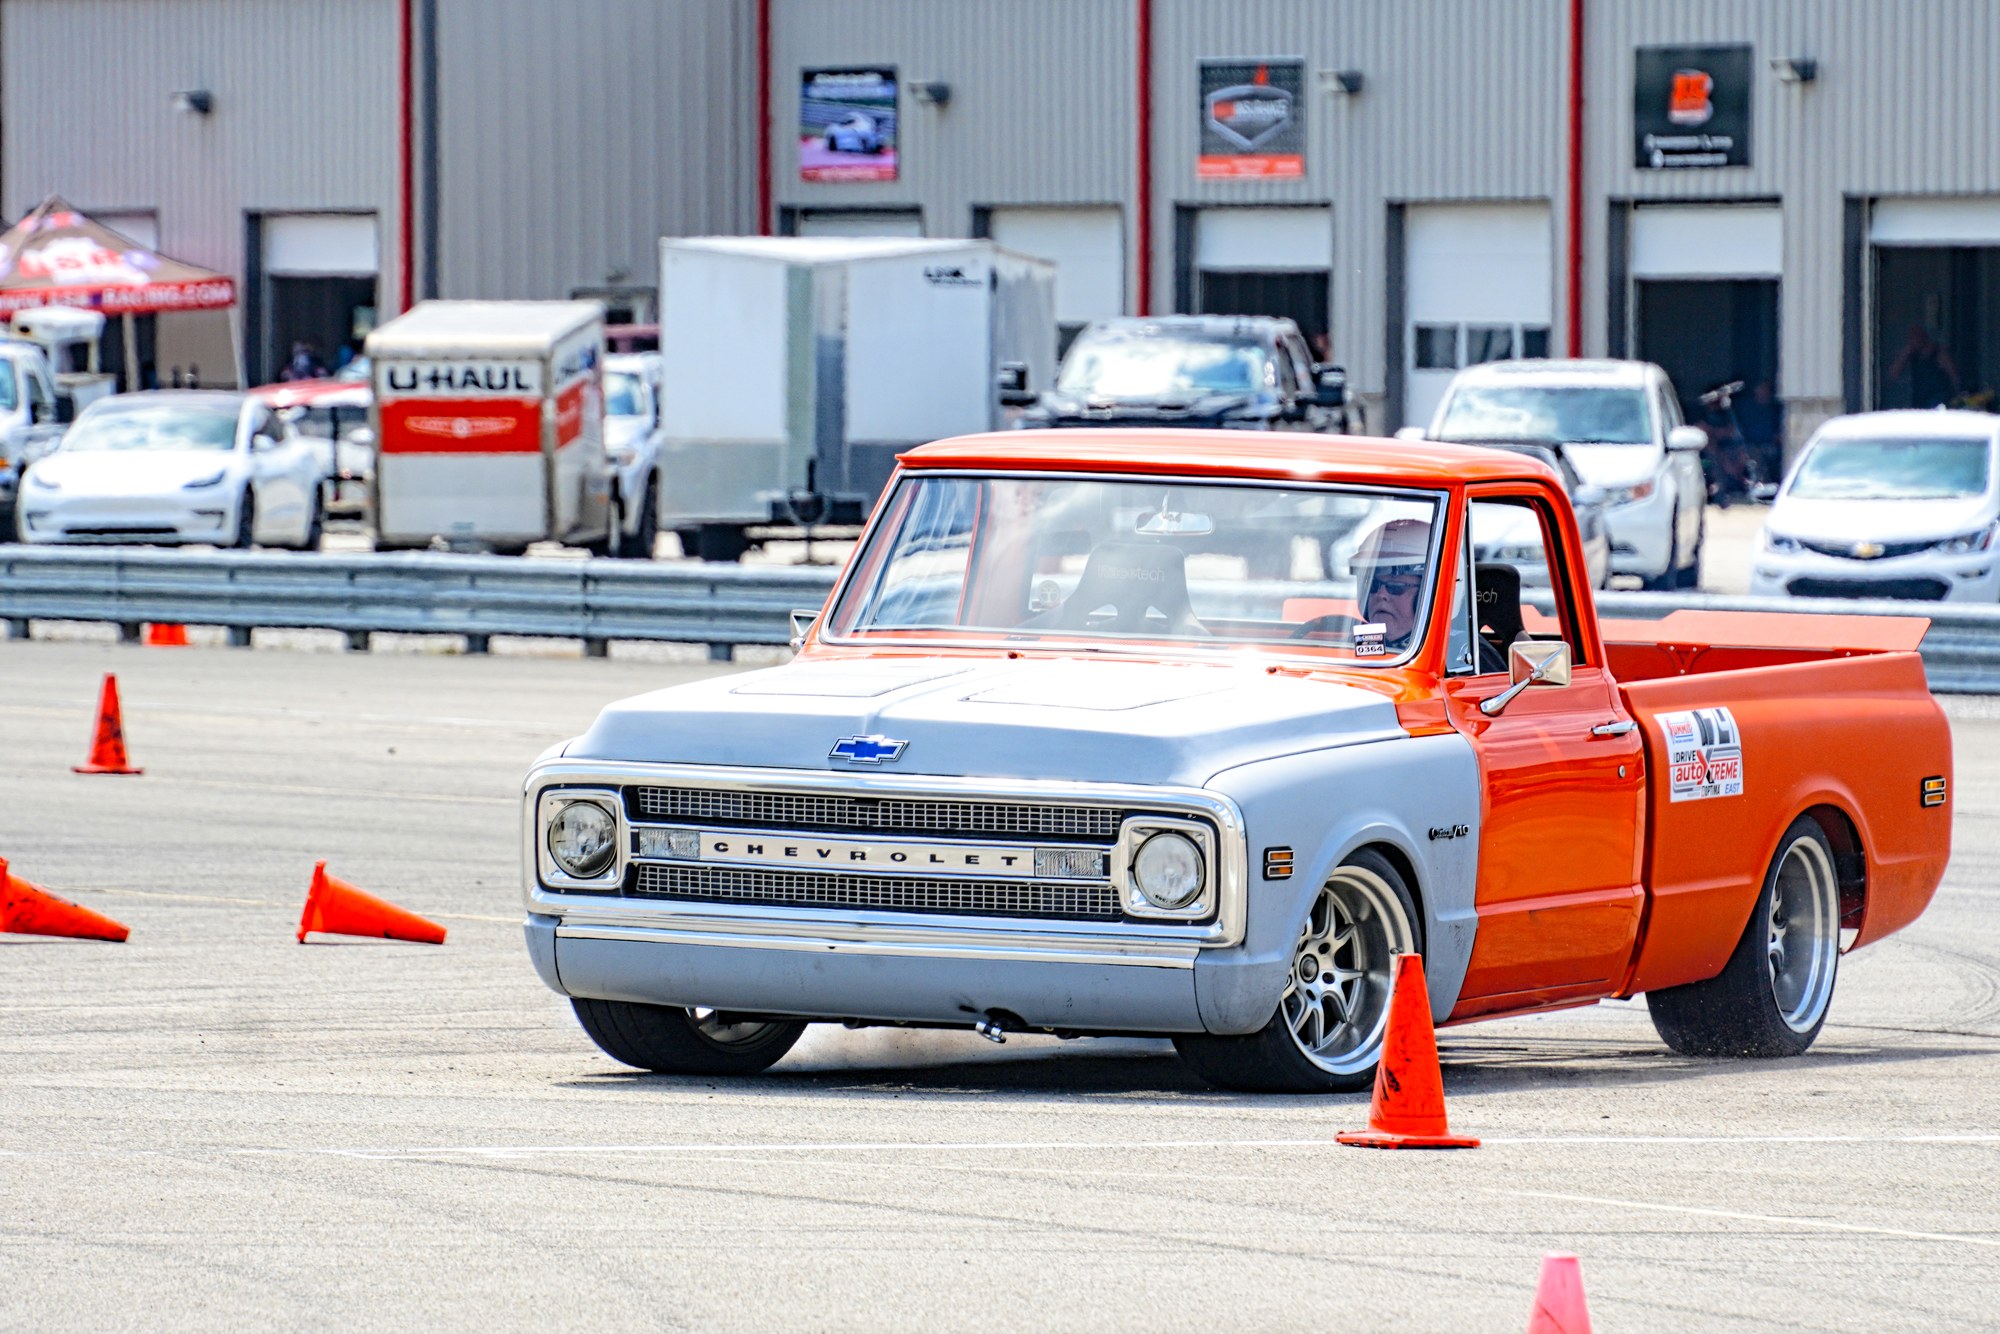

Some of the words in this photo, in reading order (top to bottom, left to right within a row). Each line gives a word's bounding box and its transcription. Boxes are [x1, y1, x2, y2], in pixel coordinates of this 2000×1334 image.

[388, 366, 533, 390] U-HAUL
[1357, 645, 1383, 654] 0364
[1725, 782, 1740, 794] EAST
[713, 841, 1019, 867] CHEVROLET
